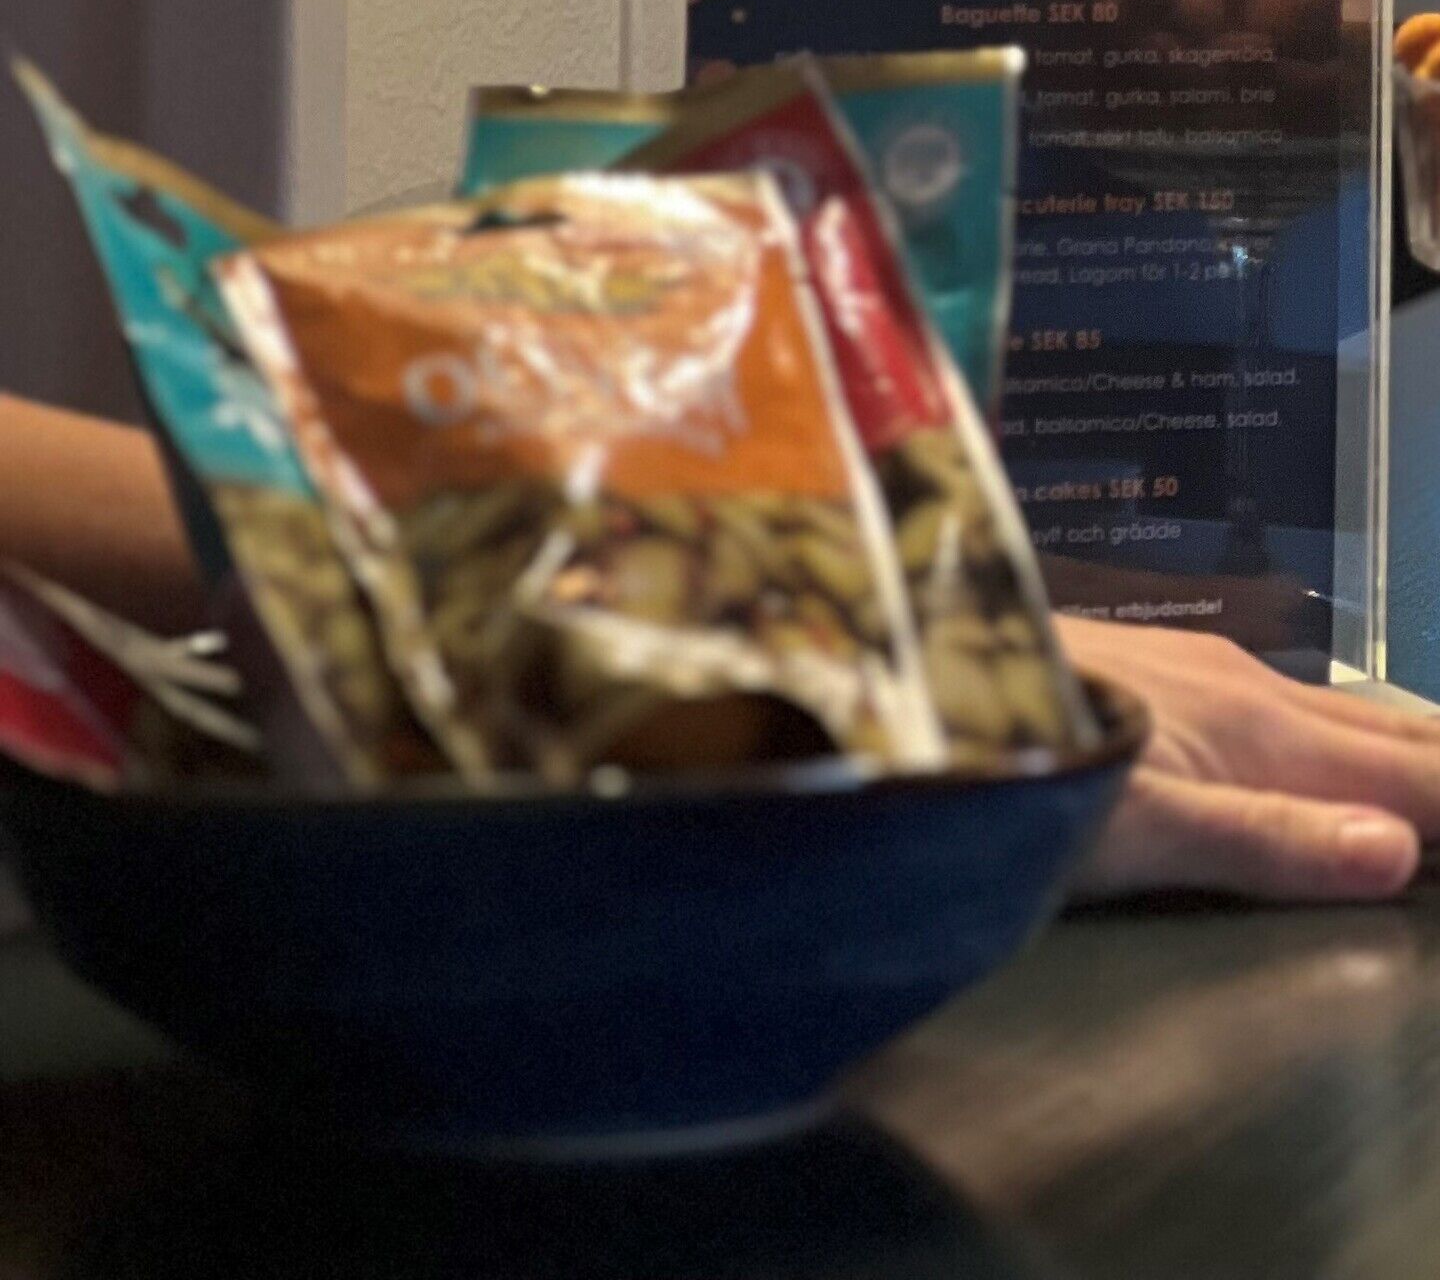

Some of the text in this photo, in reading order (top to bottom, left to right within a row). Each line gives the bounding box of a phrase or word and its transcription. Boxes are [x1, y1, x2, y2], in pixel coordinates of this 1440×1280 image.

[940, 1, 1120, 28] Baguette SEK 80
[1153, 191, 1190, 211] SEK
[1032, 330, 1068, 351] SEK
[1108, 476, 1145, 498] SEK
